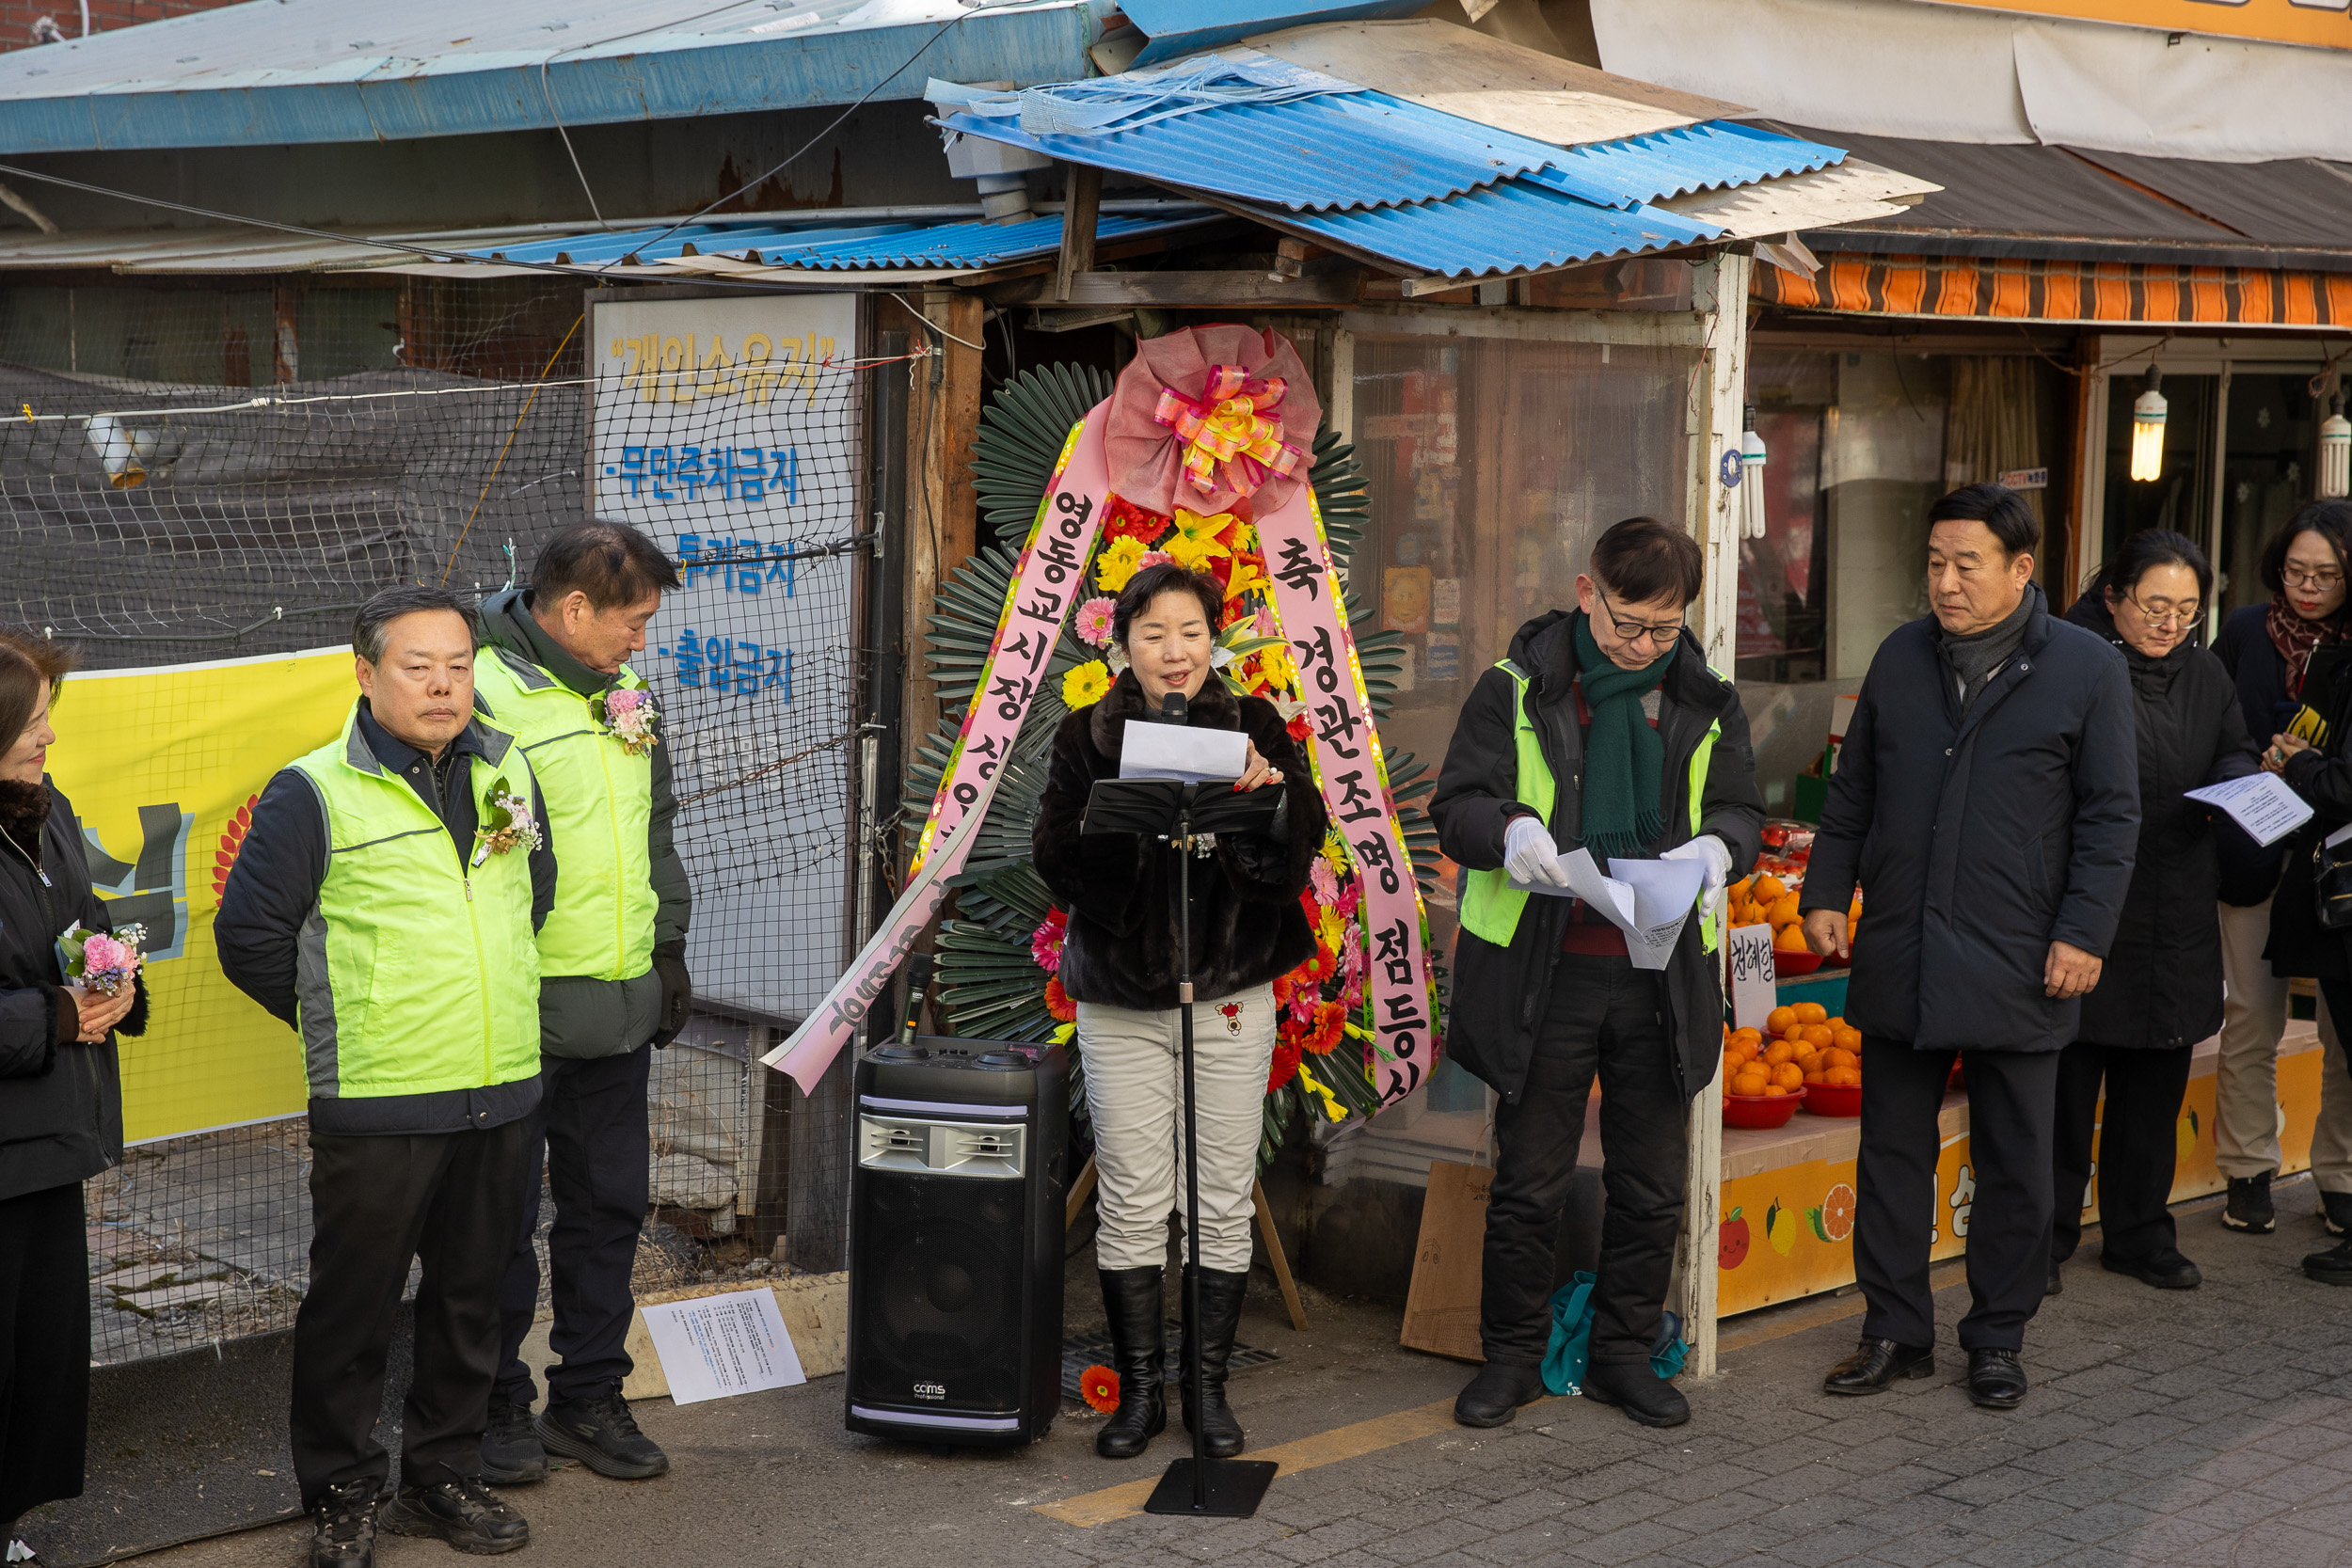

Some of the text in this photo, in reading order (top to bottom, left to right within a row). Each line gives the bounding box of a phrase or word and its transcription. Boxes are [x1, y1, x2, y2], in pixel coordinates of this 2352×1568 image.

[988, 491, 1093, 721] 영동교시장
[1274, 537, 1324, 602] 축
[1293, 626, 1400, 895] 경관조명
[1730, 934, 1774, 984] 천혜향
